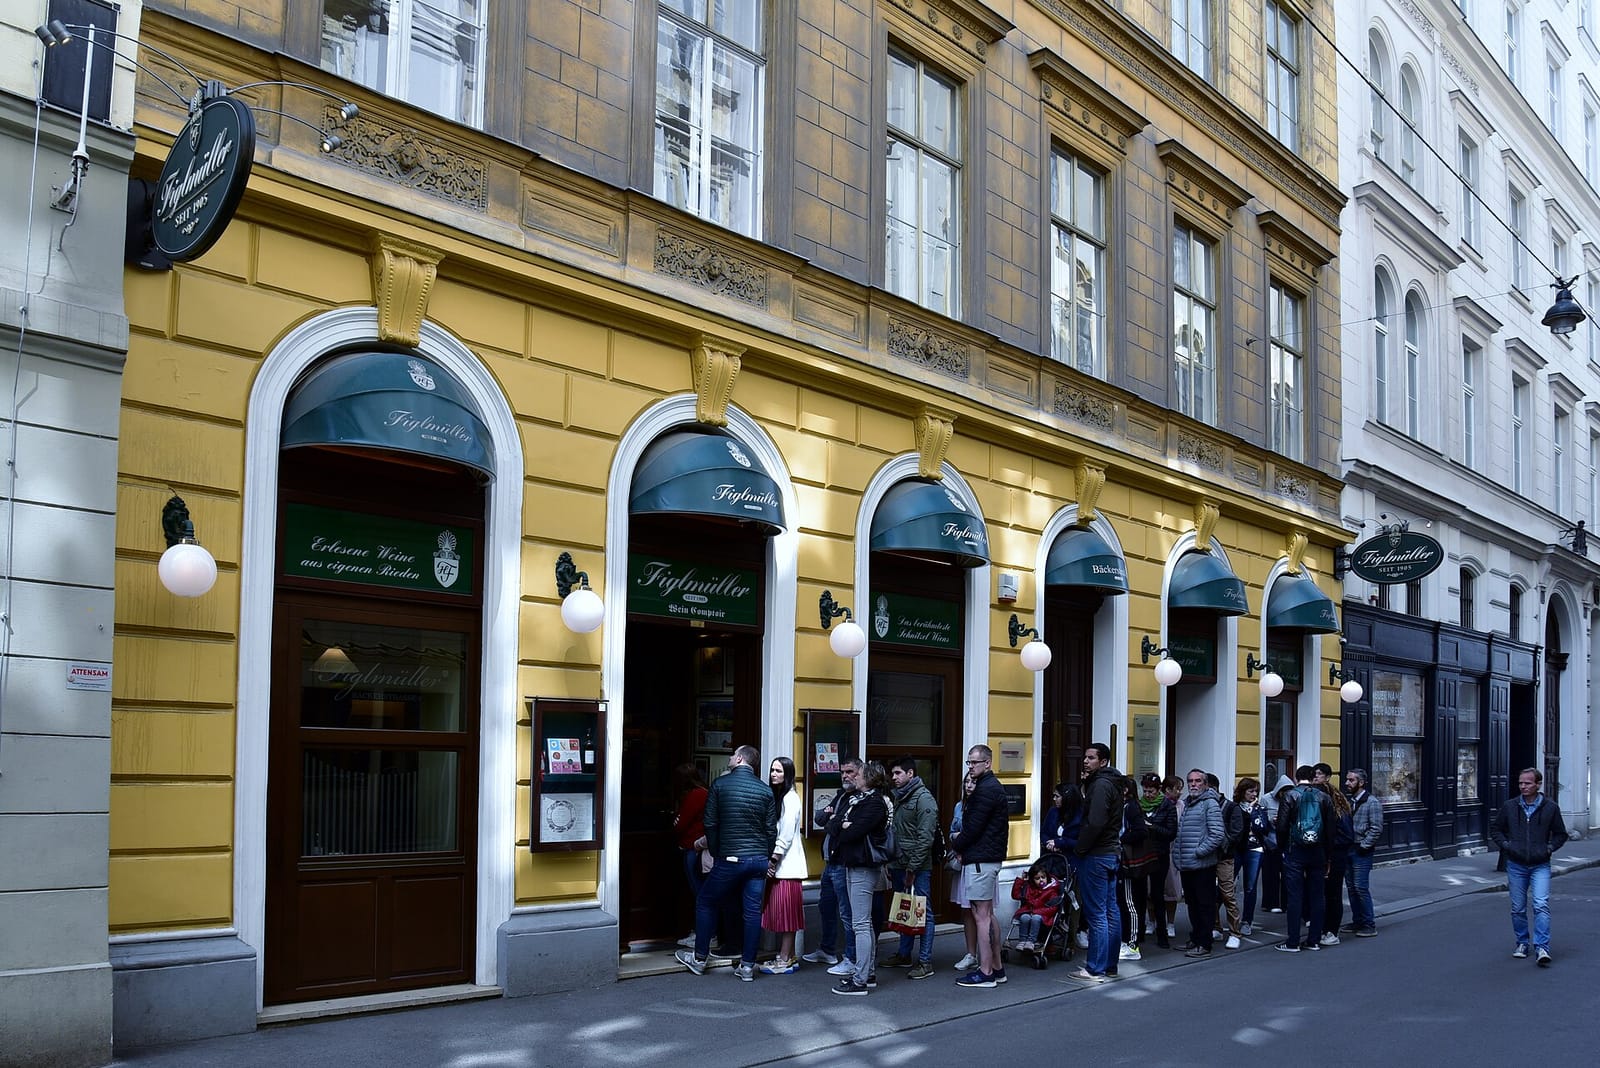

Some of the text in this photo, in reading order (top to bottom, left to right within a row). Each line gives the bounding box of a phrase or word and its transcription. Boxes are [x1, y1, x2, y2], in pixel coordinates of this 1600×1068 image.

[157, 127, 233, 219] Figlmüller
[174, 192, 209, 229] SEIT 1905
[383, 410, 472, 442] Figlmüller
[311, 535, 416, 564] Erlesene Weine
[1357, 545, 1434, 567] Figlmüller
[300, 559, 421, 580] aus eigenen Rieden
[637, 561, 751, 598] Figlmüller
[668, 603, 725, 618] Wein Comptoir
[71, 668, 108, 677] ATTENSAM
